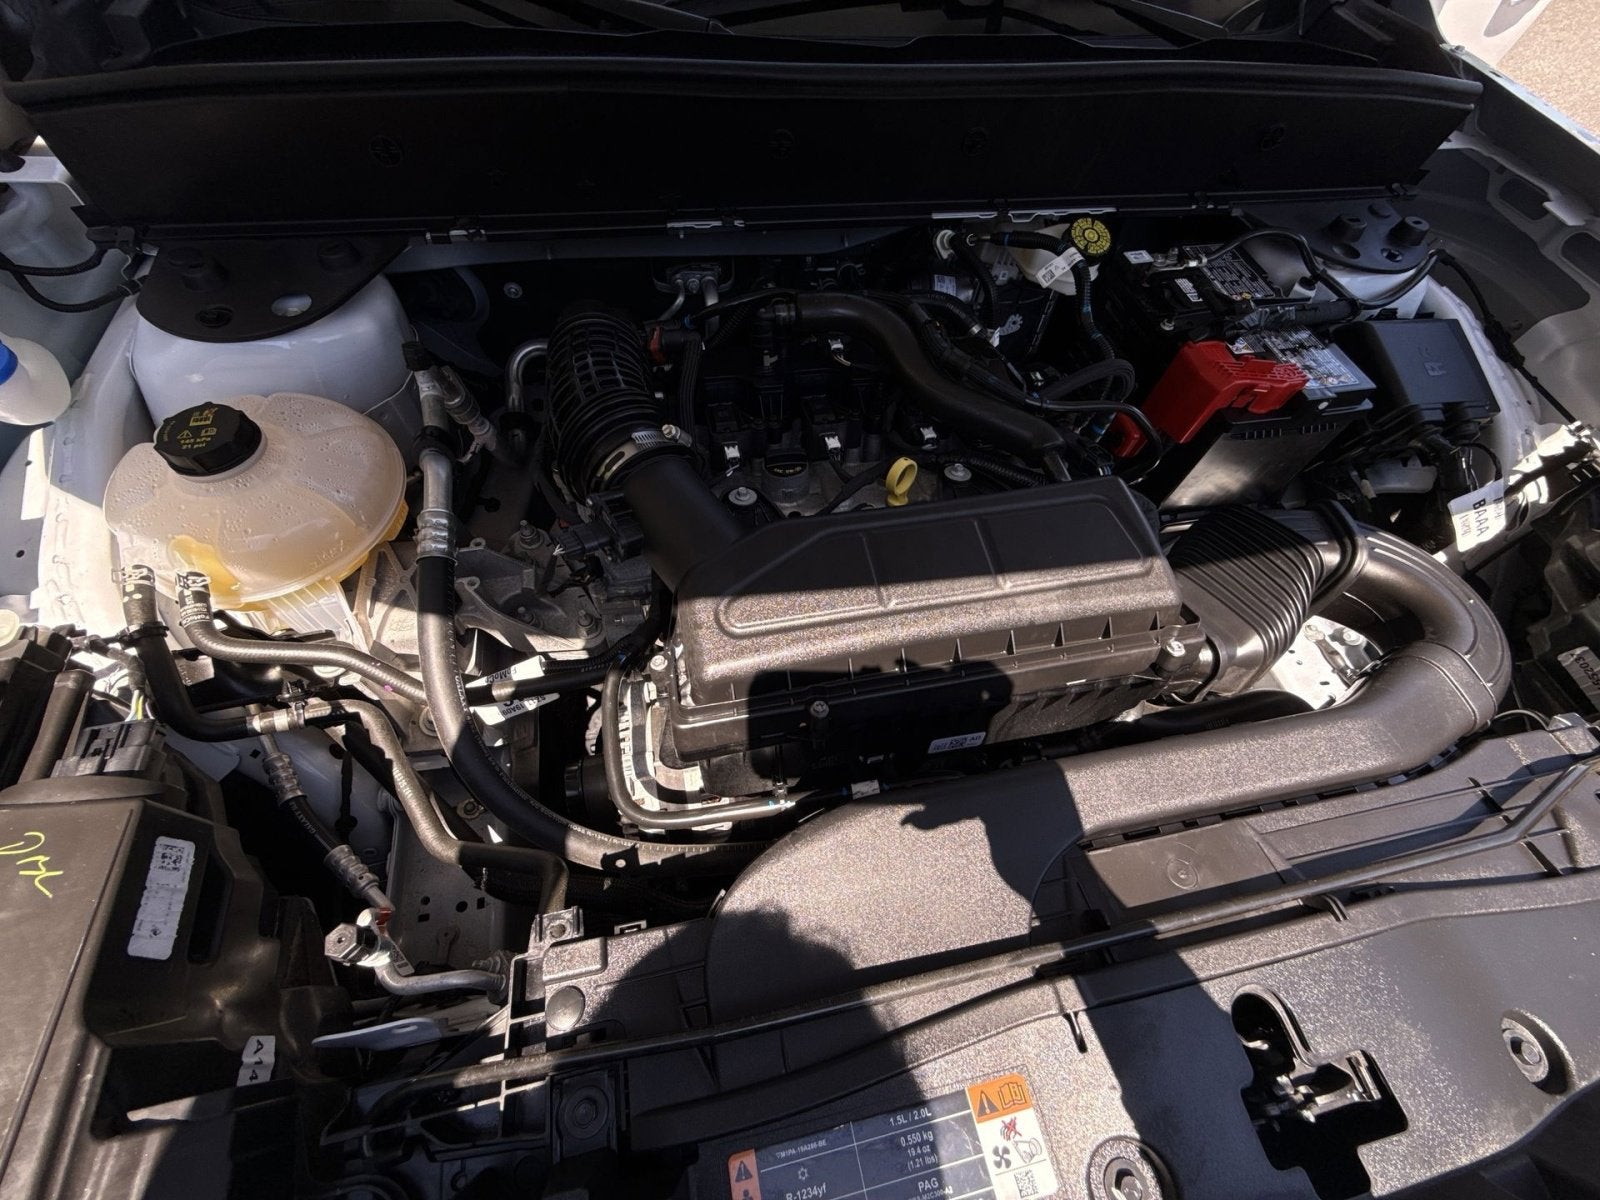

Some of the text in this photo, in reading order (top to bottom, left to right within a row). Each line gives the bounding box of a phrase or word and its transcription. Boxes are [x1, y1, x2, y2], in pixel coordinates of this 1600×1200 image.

[889, 1114, 908, 1127] 1.5L
[913, 1107, 932, 1121] 2.0L
[900, 1130, 934, 1147] 0.550 kg
[907, 1144, 931, 1158] 19.4 oz
[907, 1153, 938, 1172] (1.21 lbs)
[785, 1182, 827, 1200] R-1234yf
[918, 1177, 939, 1193] PAG
